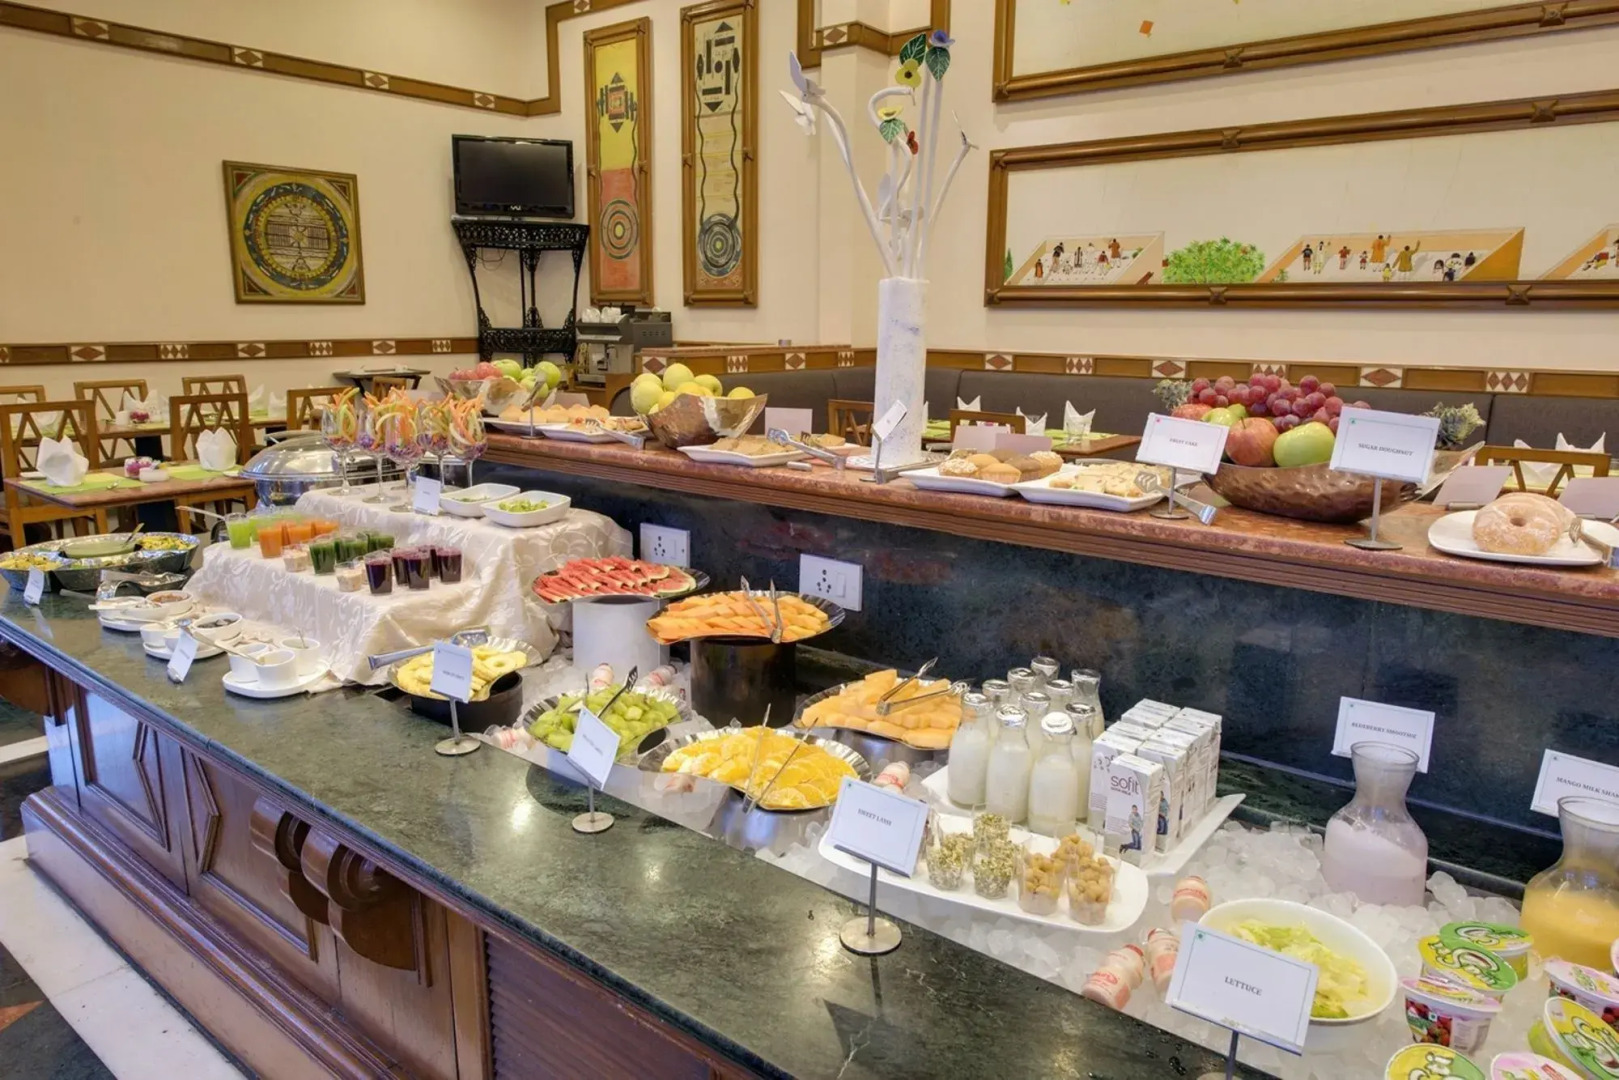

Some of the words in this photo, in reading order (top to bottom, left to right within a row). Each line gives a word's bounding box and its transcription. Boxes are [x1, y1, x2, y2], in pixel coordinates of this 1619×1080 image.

[1111, 776, 1140, 795] sofit
[1556, 776, 1582, 788] MANGO
[1582, 783, 1600, 793] MILK
[1225, 976, 1262, 996] LETTUCE
